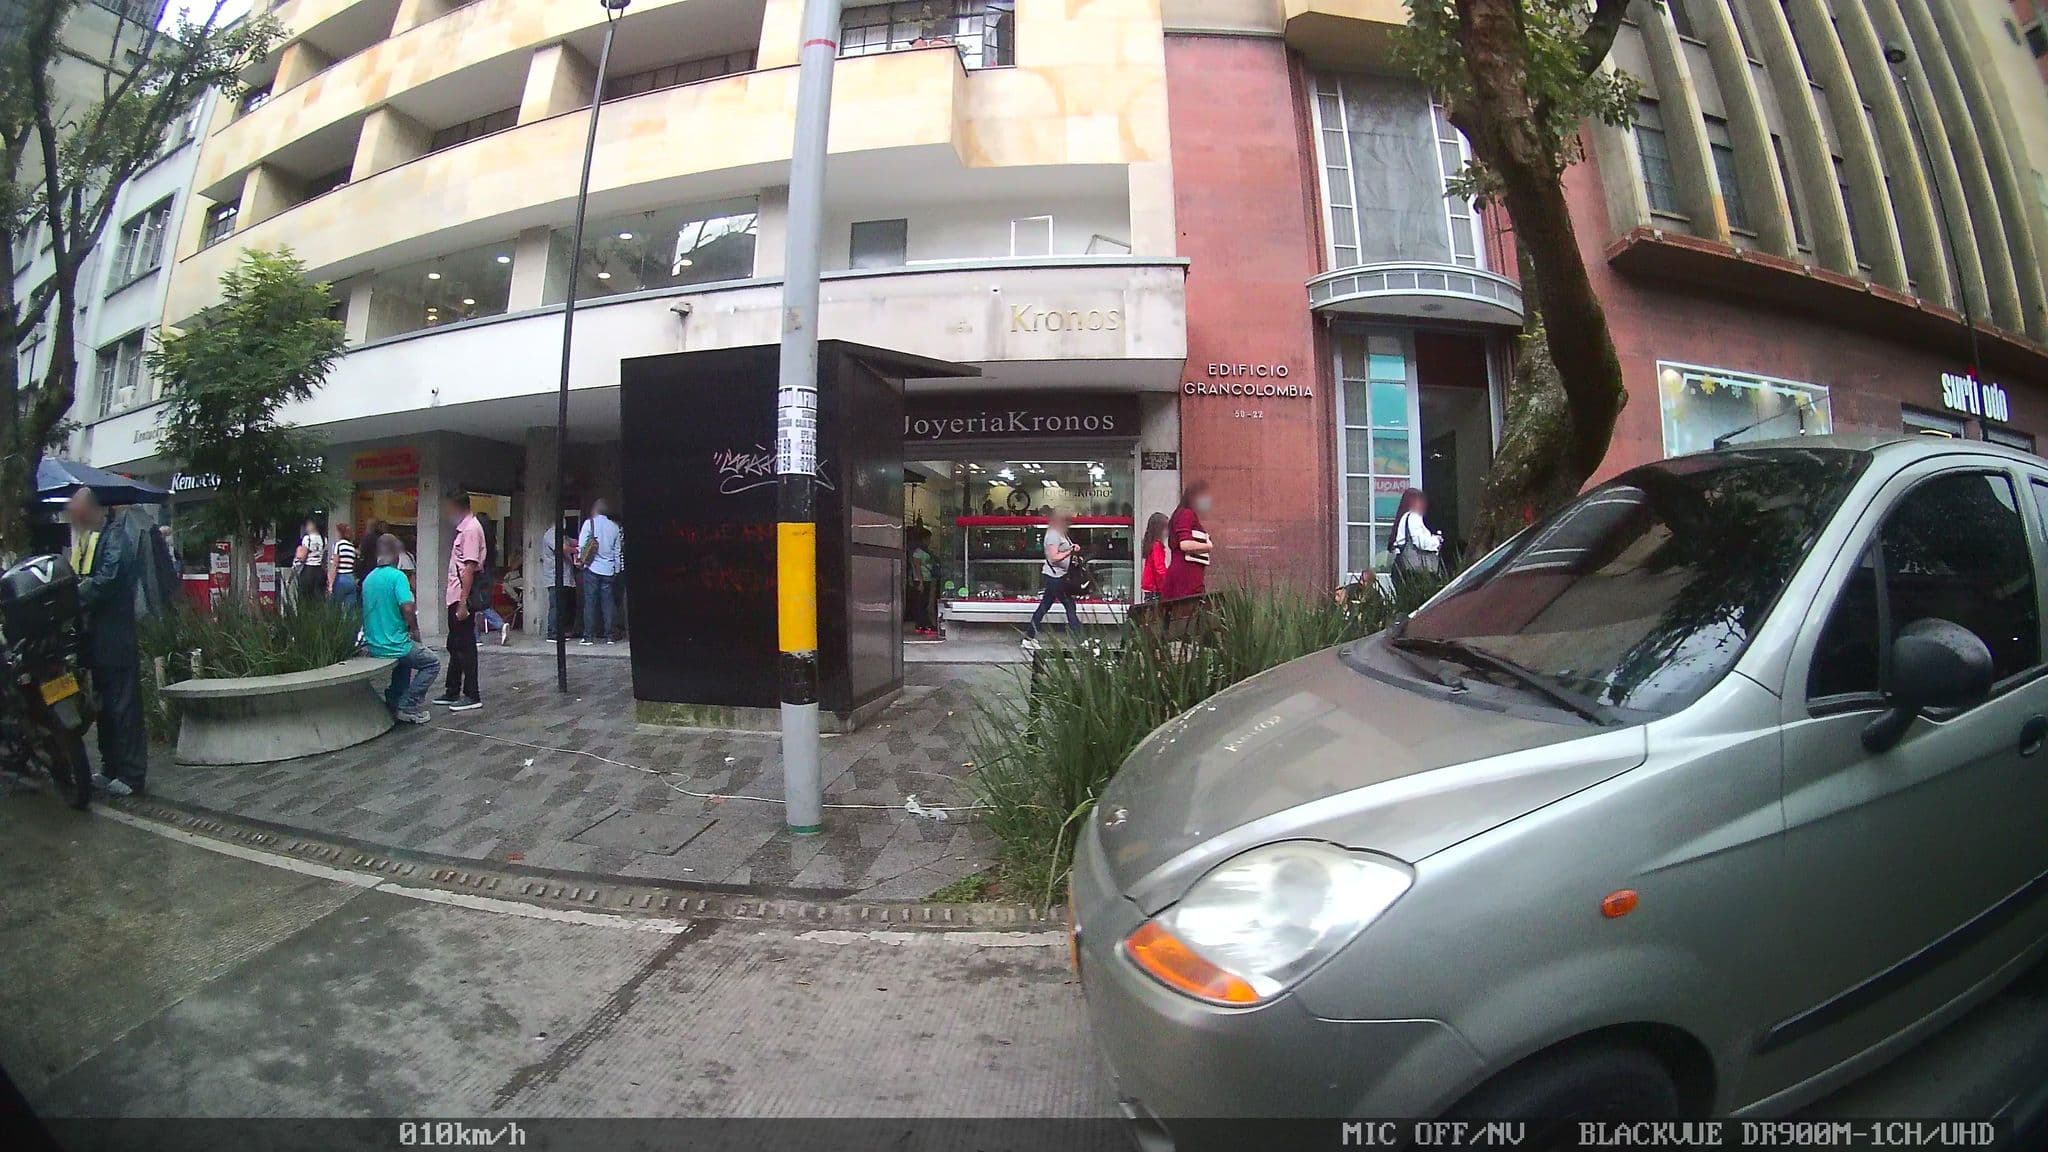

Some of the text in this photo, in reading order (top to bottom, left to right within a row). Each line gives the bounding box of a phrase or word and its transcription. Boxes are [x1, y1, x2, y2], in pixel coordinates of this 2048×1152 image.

[1010, 304, 1120, 333] Kronos
[1208, 363, 1289, 378] EDIFICIO
[1184, 382, 1314, 397] GRANCOLOMBIA
[1941, 367, 2009, 423] surtiodo
[904, 411, 1115, 440] JoyeriaKronos
